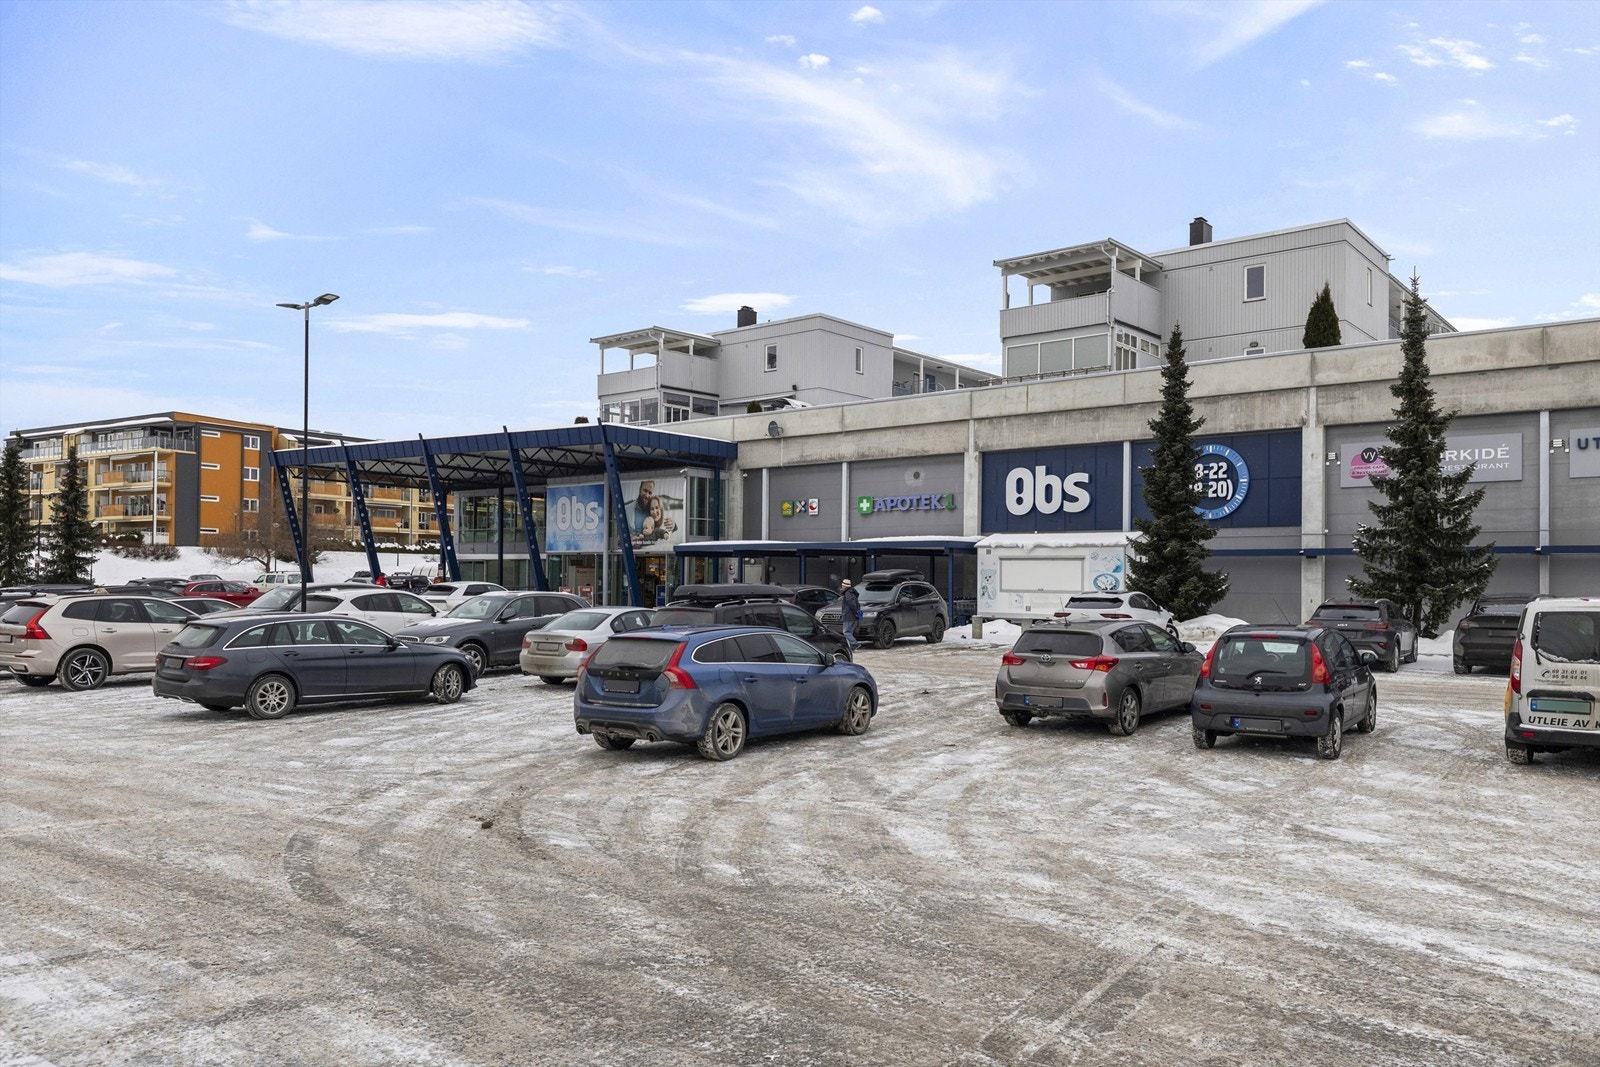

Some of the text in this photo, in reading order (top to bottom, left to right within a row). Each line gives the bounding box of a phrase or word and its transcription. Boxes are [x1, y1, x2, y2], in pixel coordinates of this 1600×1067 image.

[1440, 443, 1510, 461] RKIDÉ
[1440, 462, 1510, 472] RESTURANT
[1005, 465, 1090, 516] Obs
[556, 496, 599, 531] Obs
[1528, 715, 1568, 727] UTLEIE
[1572, 719, 1590, 728] AV
